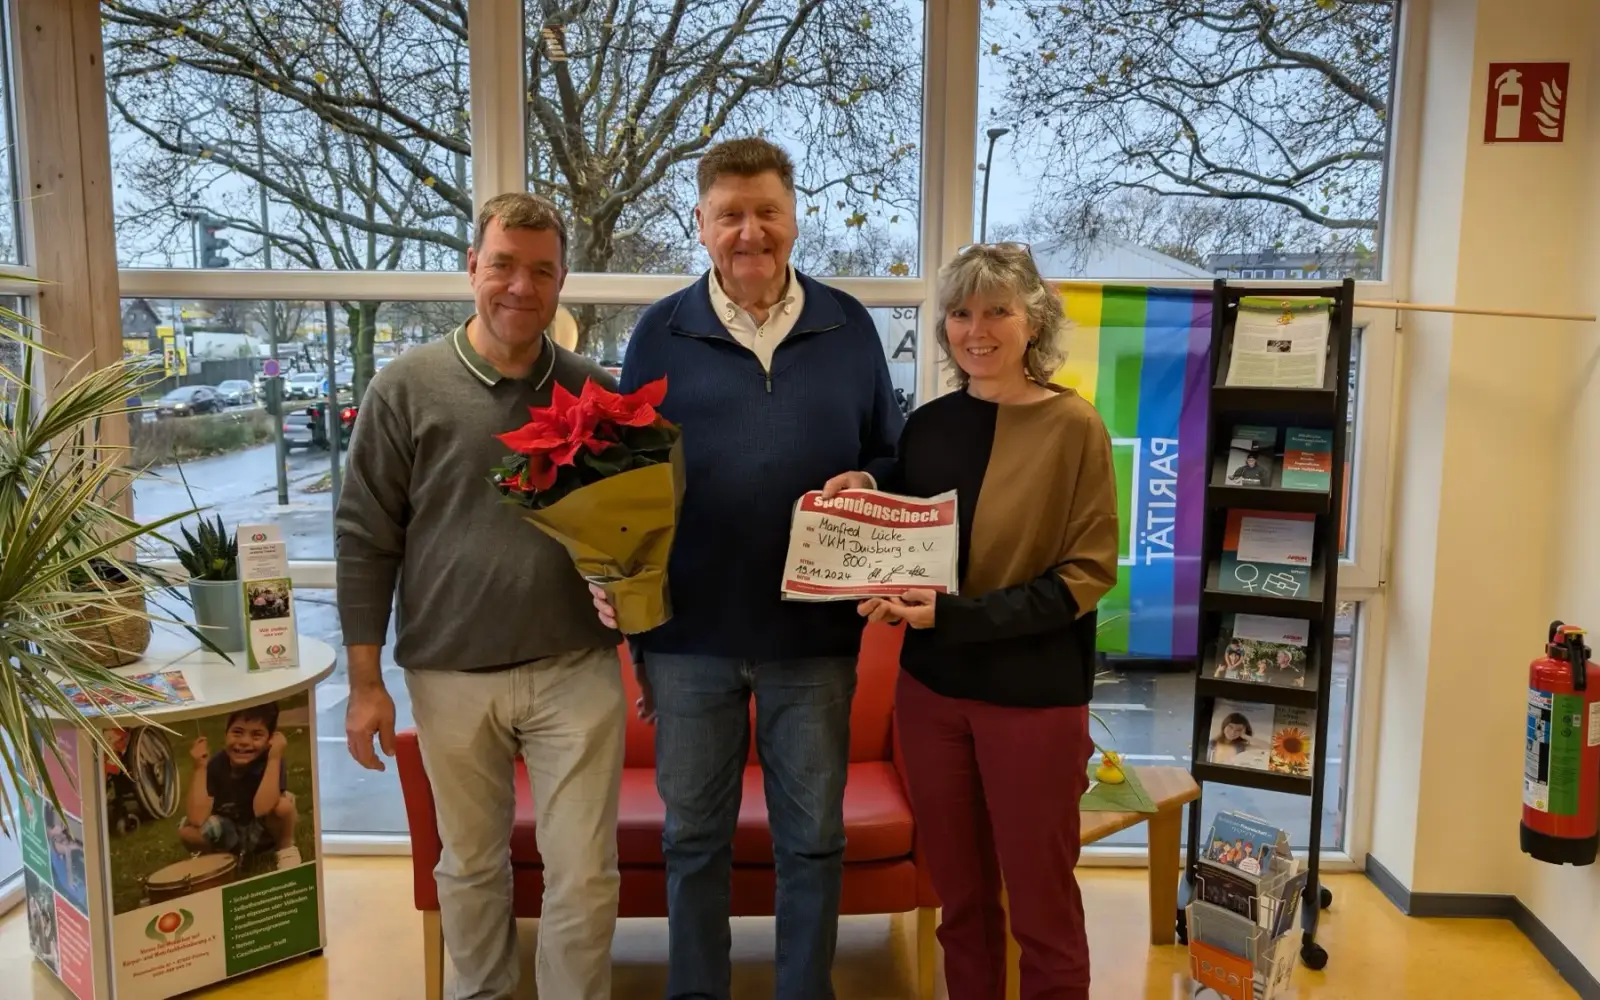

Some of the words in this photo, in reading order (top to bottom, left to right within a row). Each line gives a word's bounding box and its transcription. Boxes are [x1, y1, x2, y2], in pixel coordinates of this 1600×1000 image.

[818, 516, 861, 538] Manfred
[870, 527, 906, 541] Lücke
[818, 532, 846, 550] VKM
[849, 540, 901, 558] Duisburg
